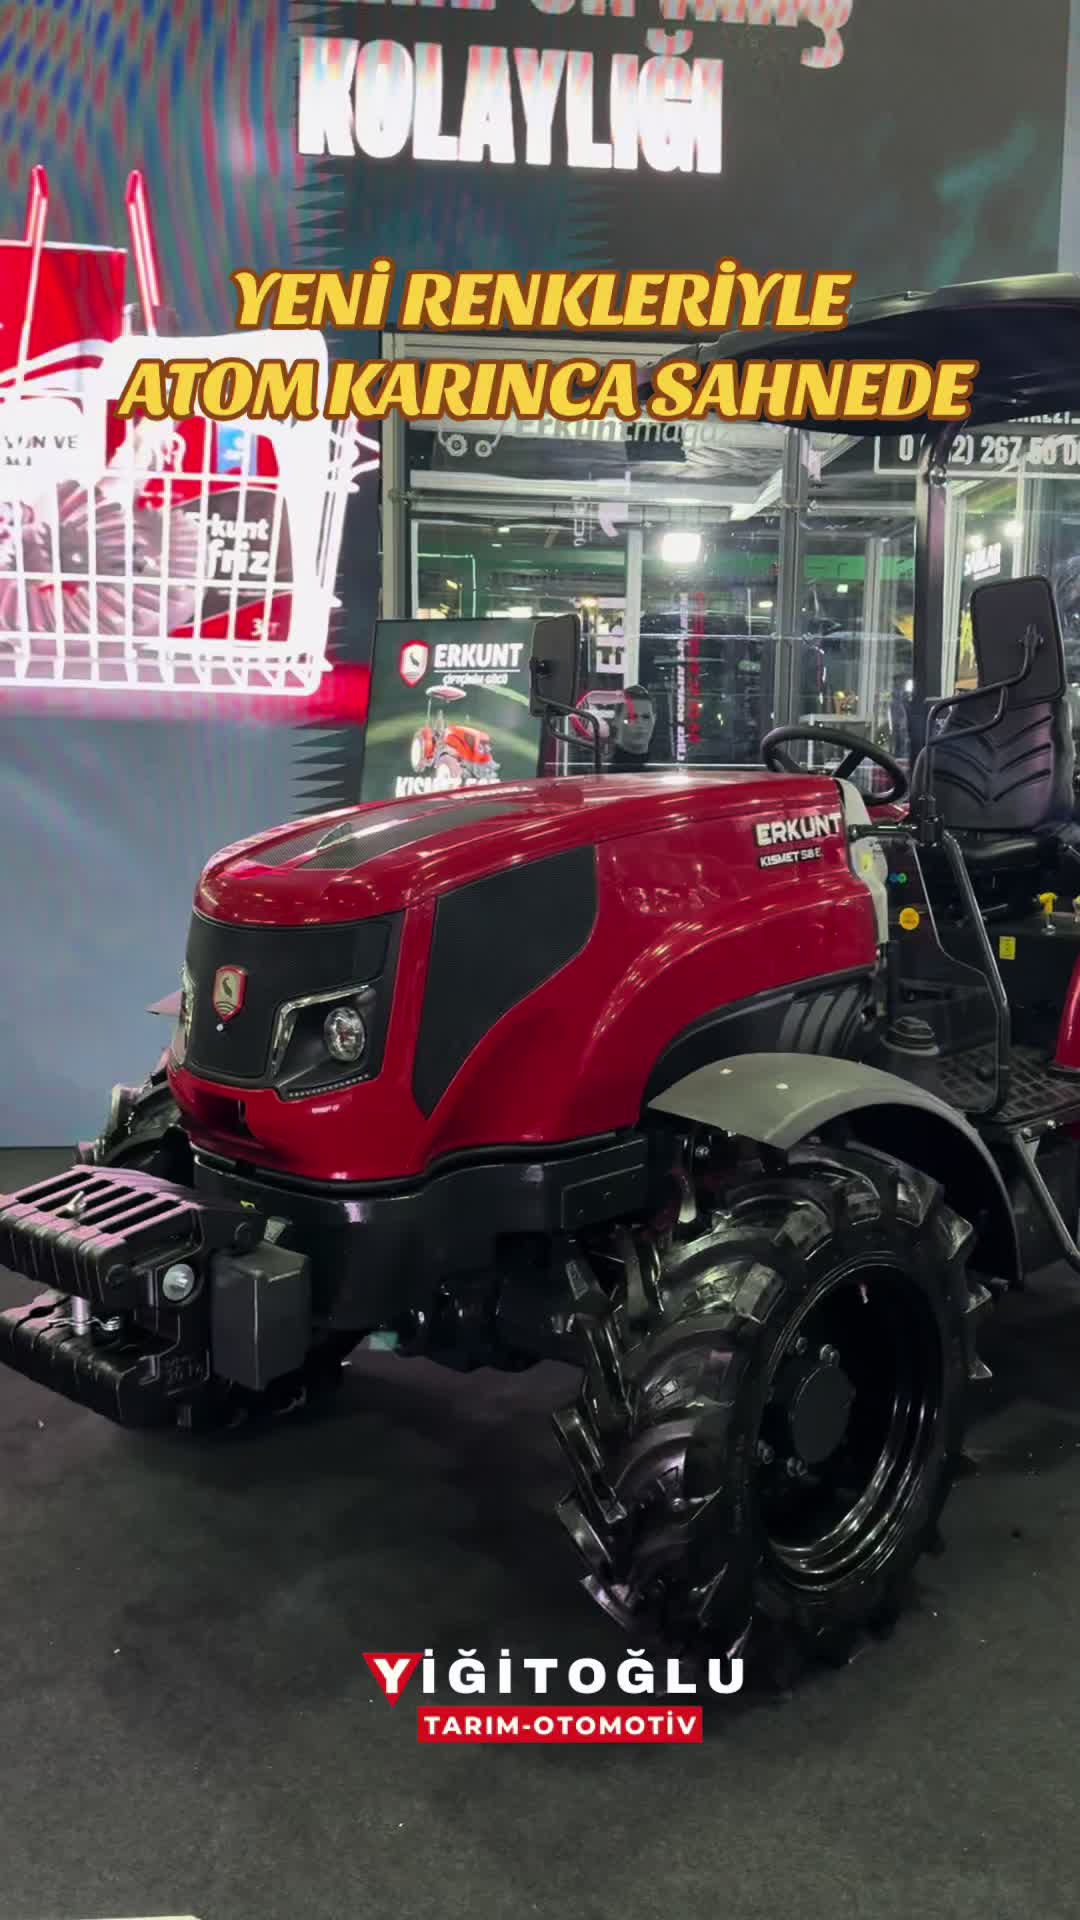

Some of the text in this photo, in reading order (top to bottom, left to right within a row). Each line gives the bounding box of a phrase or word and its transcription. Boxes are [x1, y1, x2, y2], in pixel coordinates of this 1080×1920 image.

[299, 28, 723, 174] KOLAYLIĞI
[980, 436, 1024, 465] 267
[433, 643, 524, 668] ERKUNT
[755, 813, 842, 847] ERKUNT
[760, 850, 800, 868] KISMET
